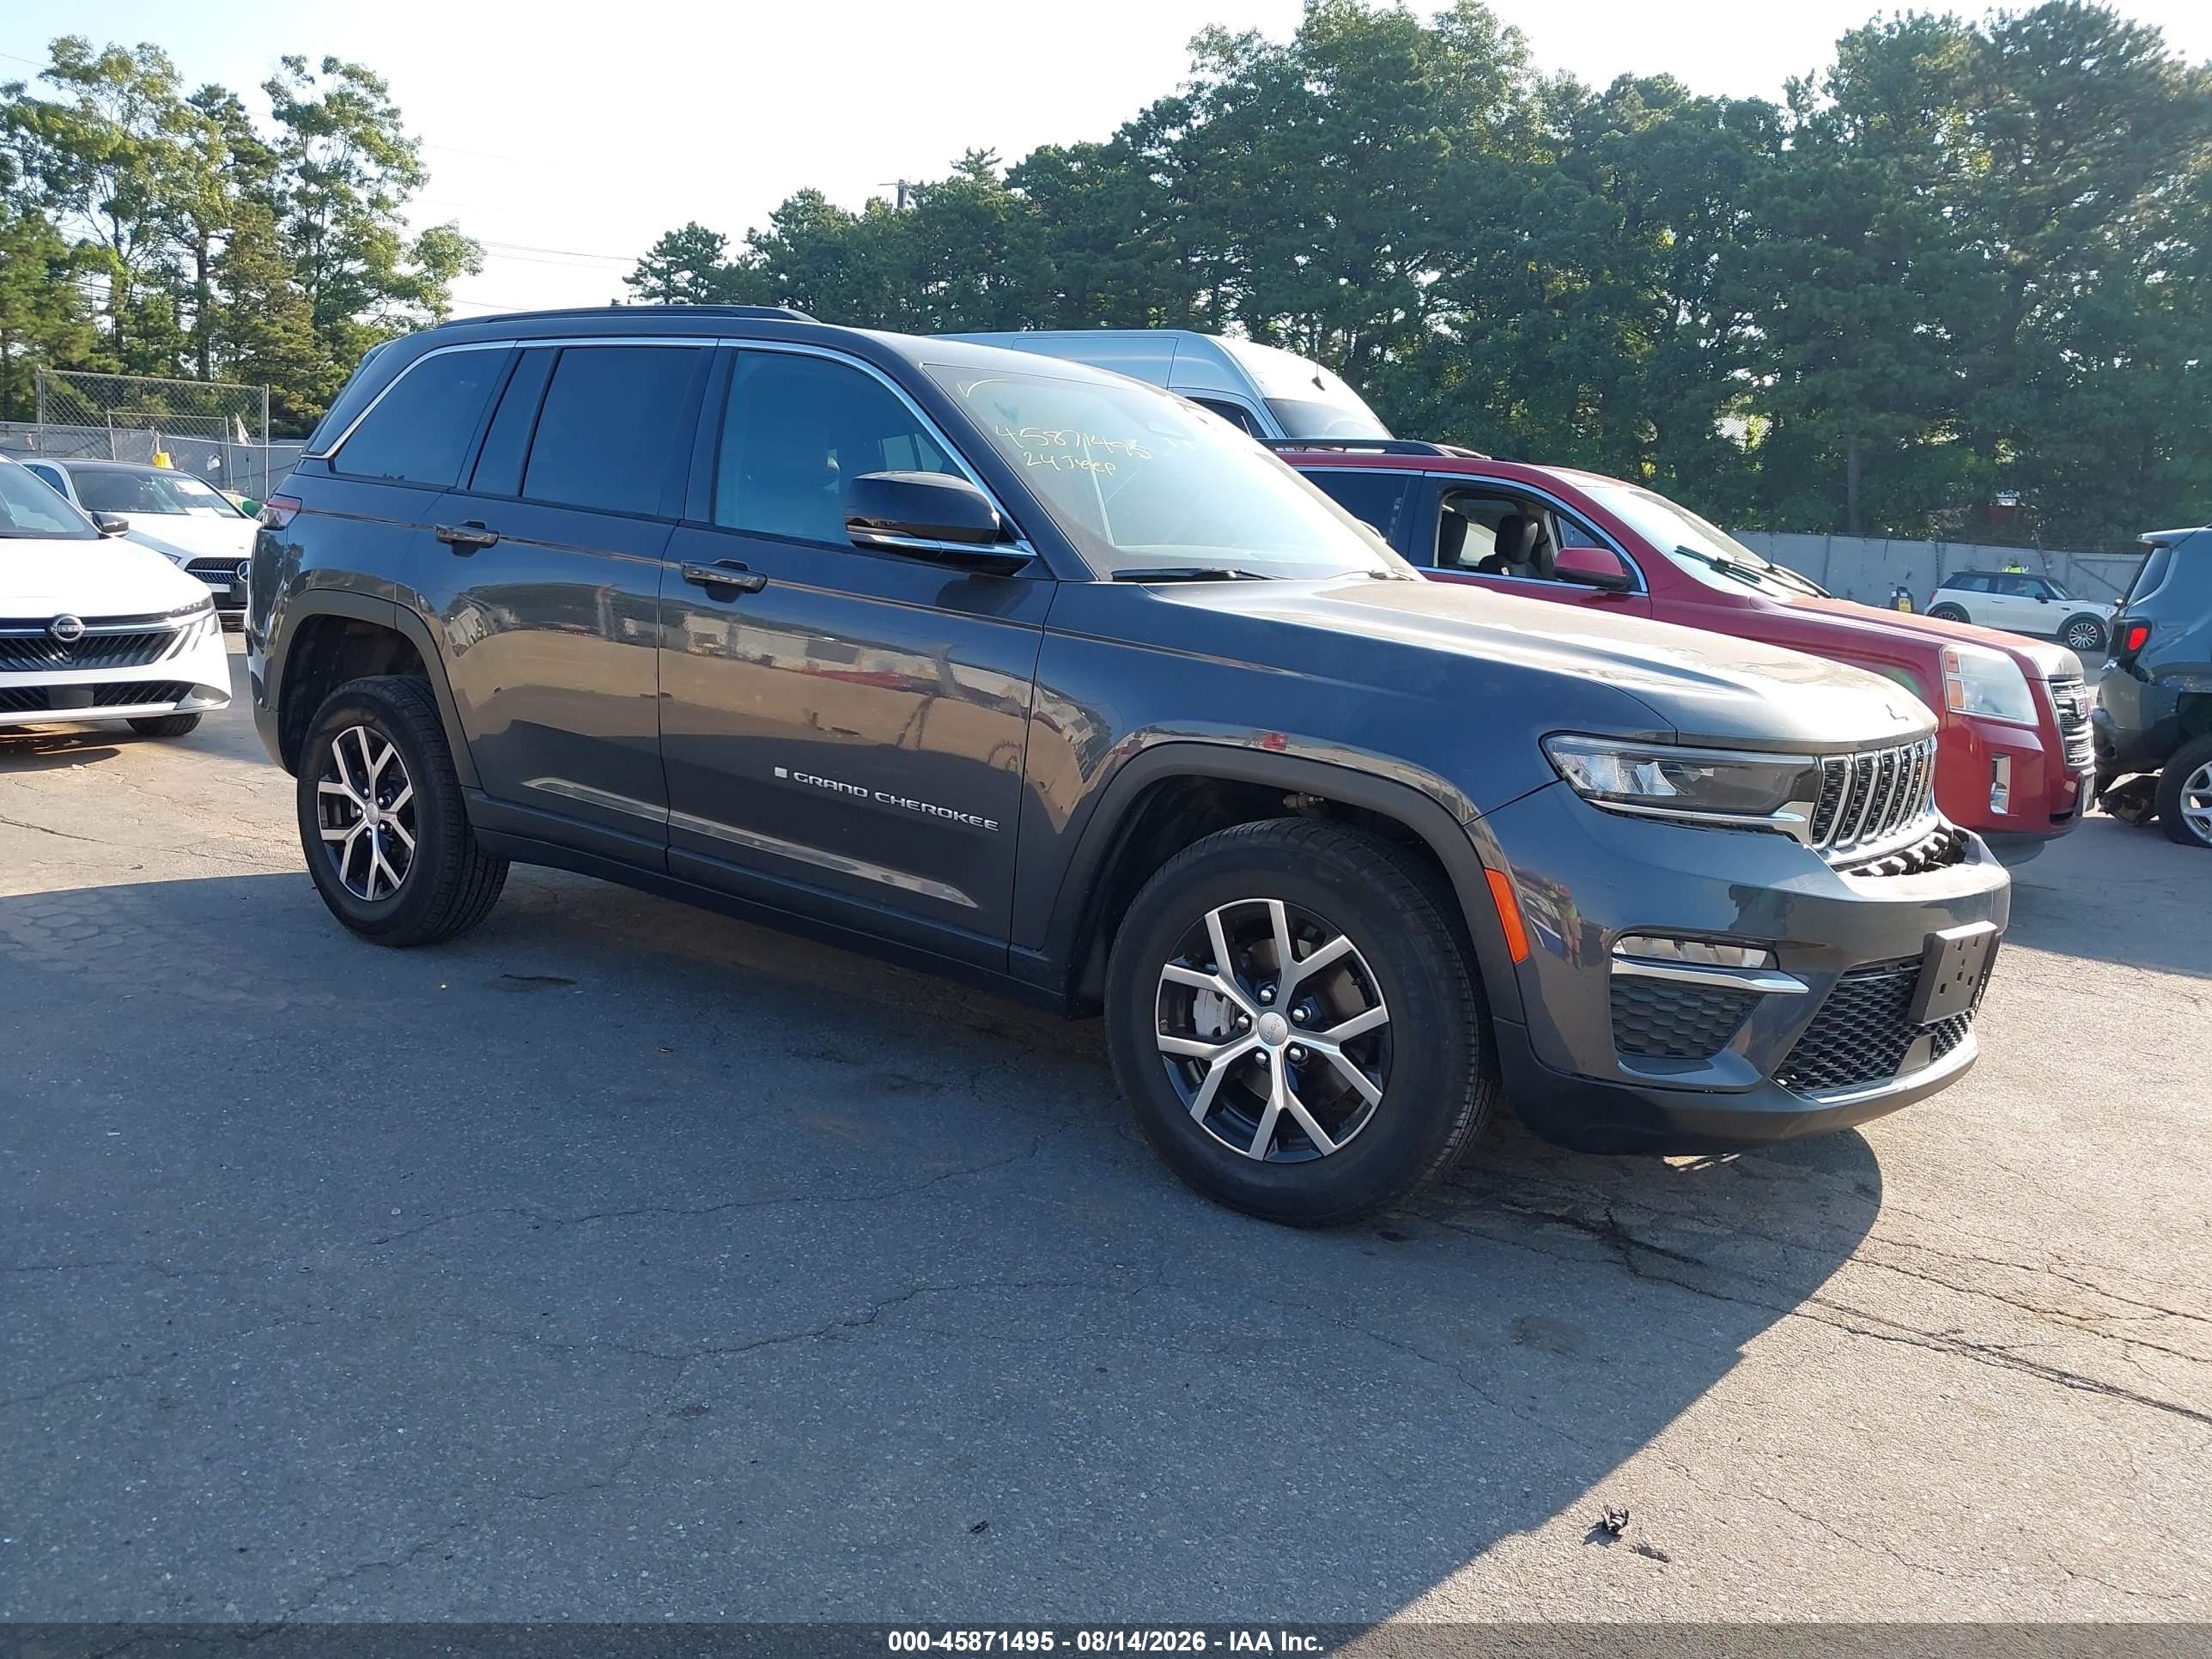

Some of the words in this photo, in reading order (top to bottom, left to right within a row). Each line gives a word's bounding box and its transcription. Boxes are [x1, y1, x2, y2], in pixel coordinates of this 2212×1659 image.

[1023, 452, 1060, 471] 24
[1061, 455, 1117, 476] Jeep
[793, 771, 869, 799] GRAND
[874, 791, 1000, 832] CHEROKEE
